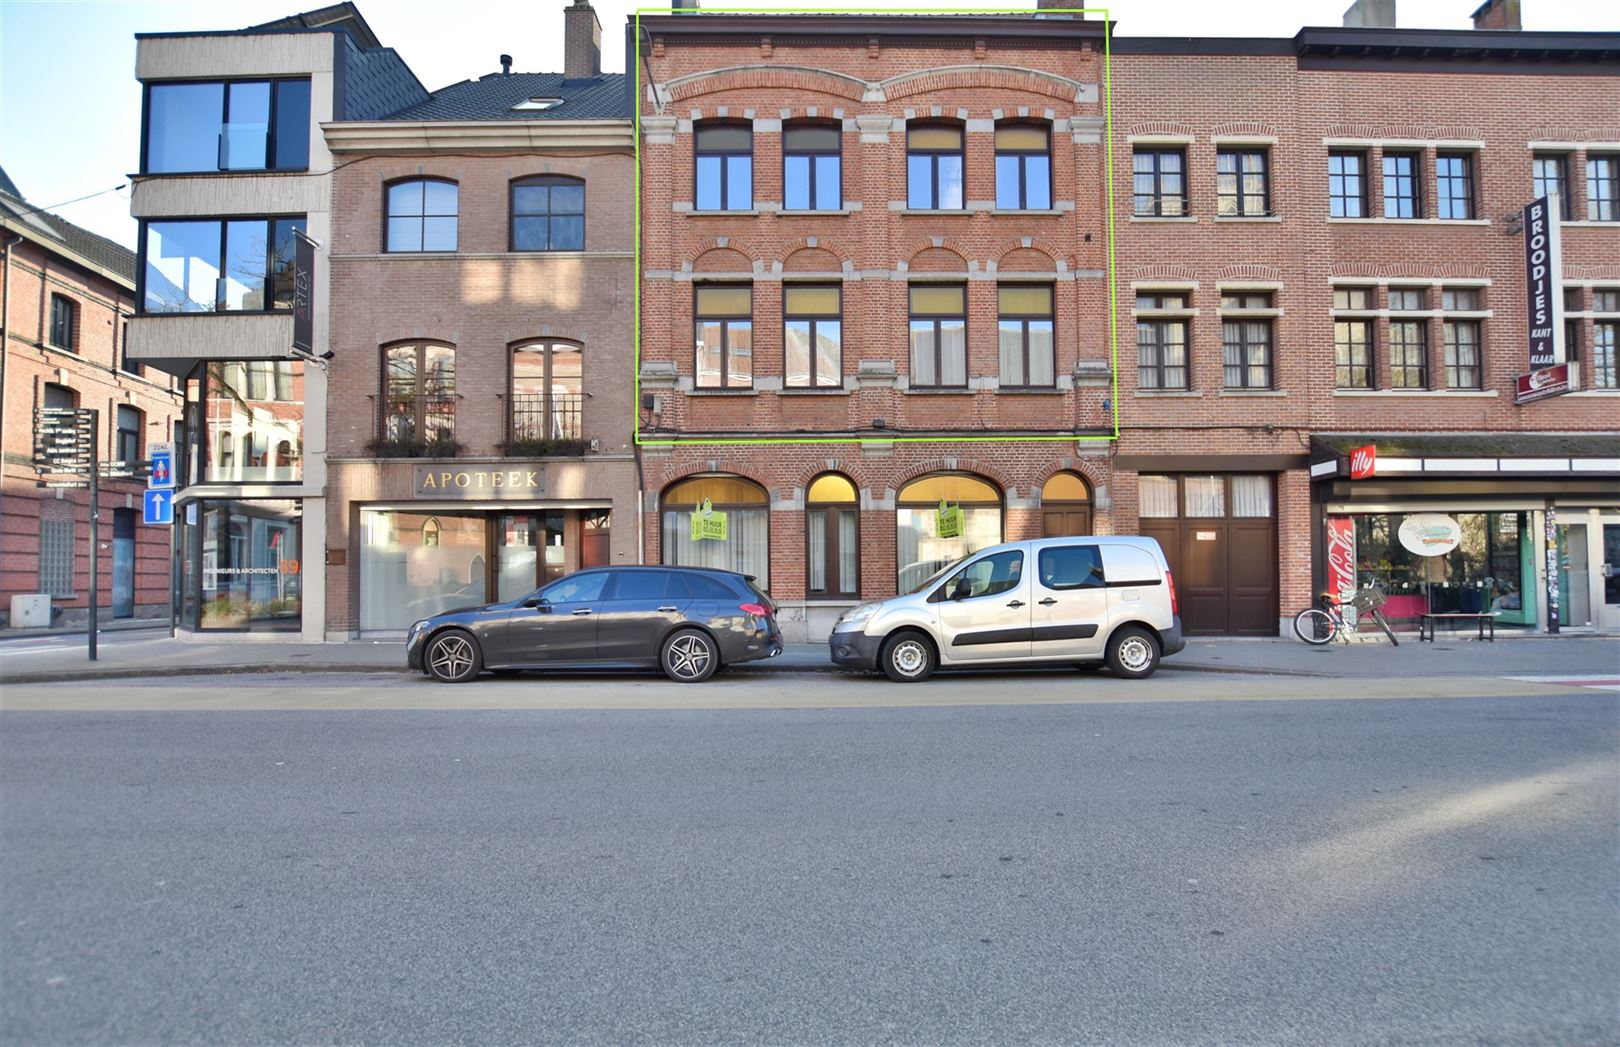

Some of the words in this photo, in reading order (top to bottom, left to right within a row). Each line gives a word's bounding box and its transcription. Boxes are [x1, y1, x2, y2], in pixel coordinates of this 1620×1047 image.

[1530, 204, 1546, 325] BROODJES
[1531, 328, 1552, 338] KANT
[1537, 342, 1544, 351] &
[1530, 354, 1554, 364] KLAAR
[1351, 450, 1373, 476] illy
[423, 471, 538, 488] APOTEEK
